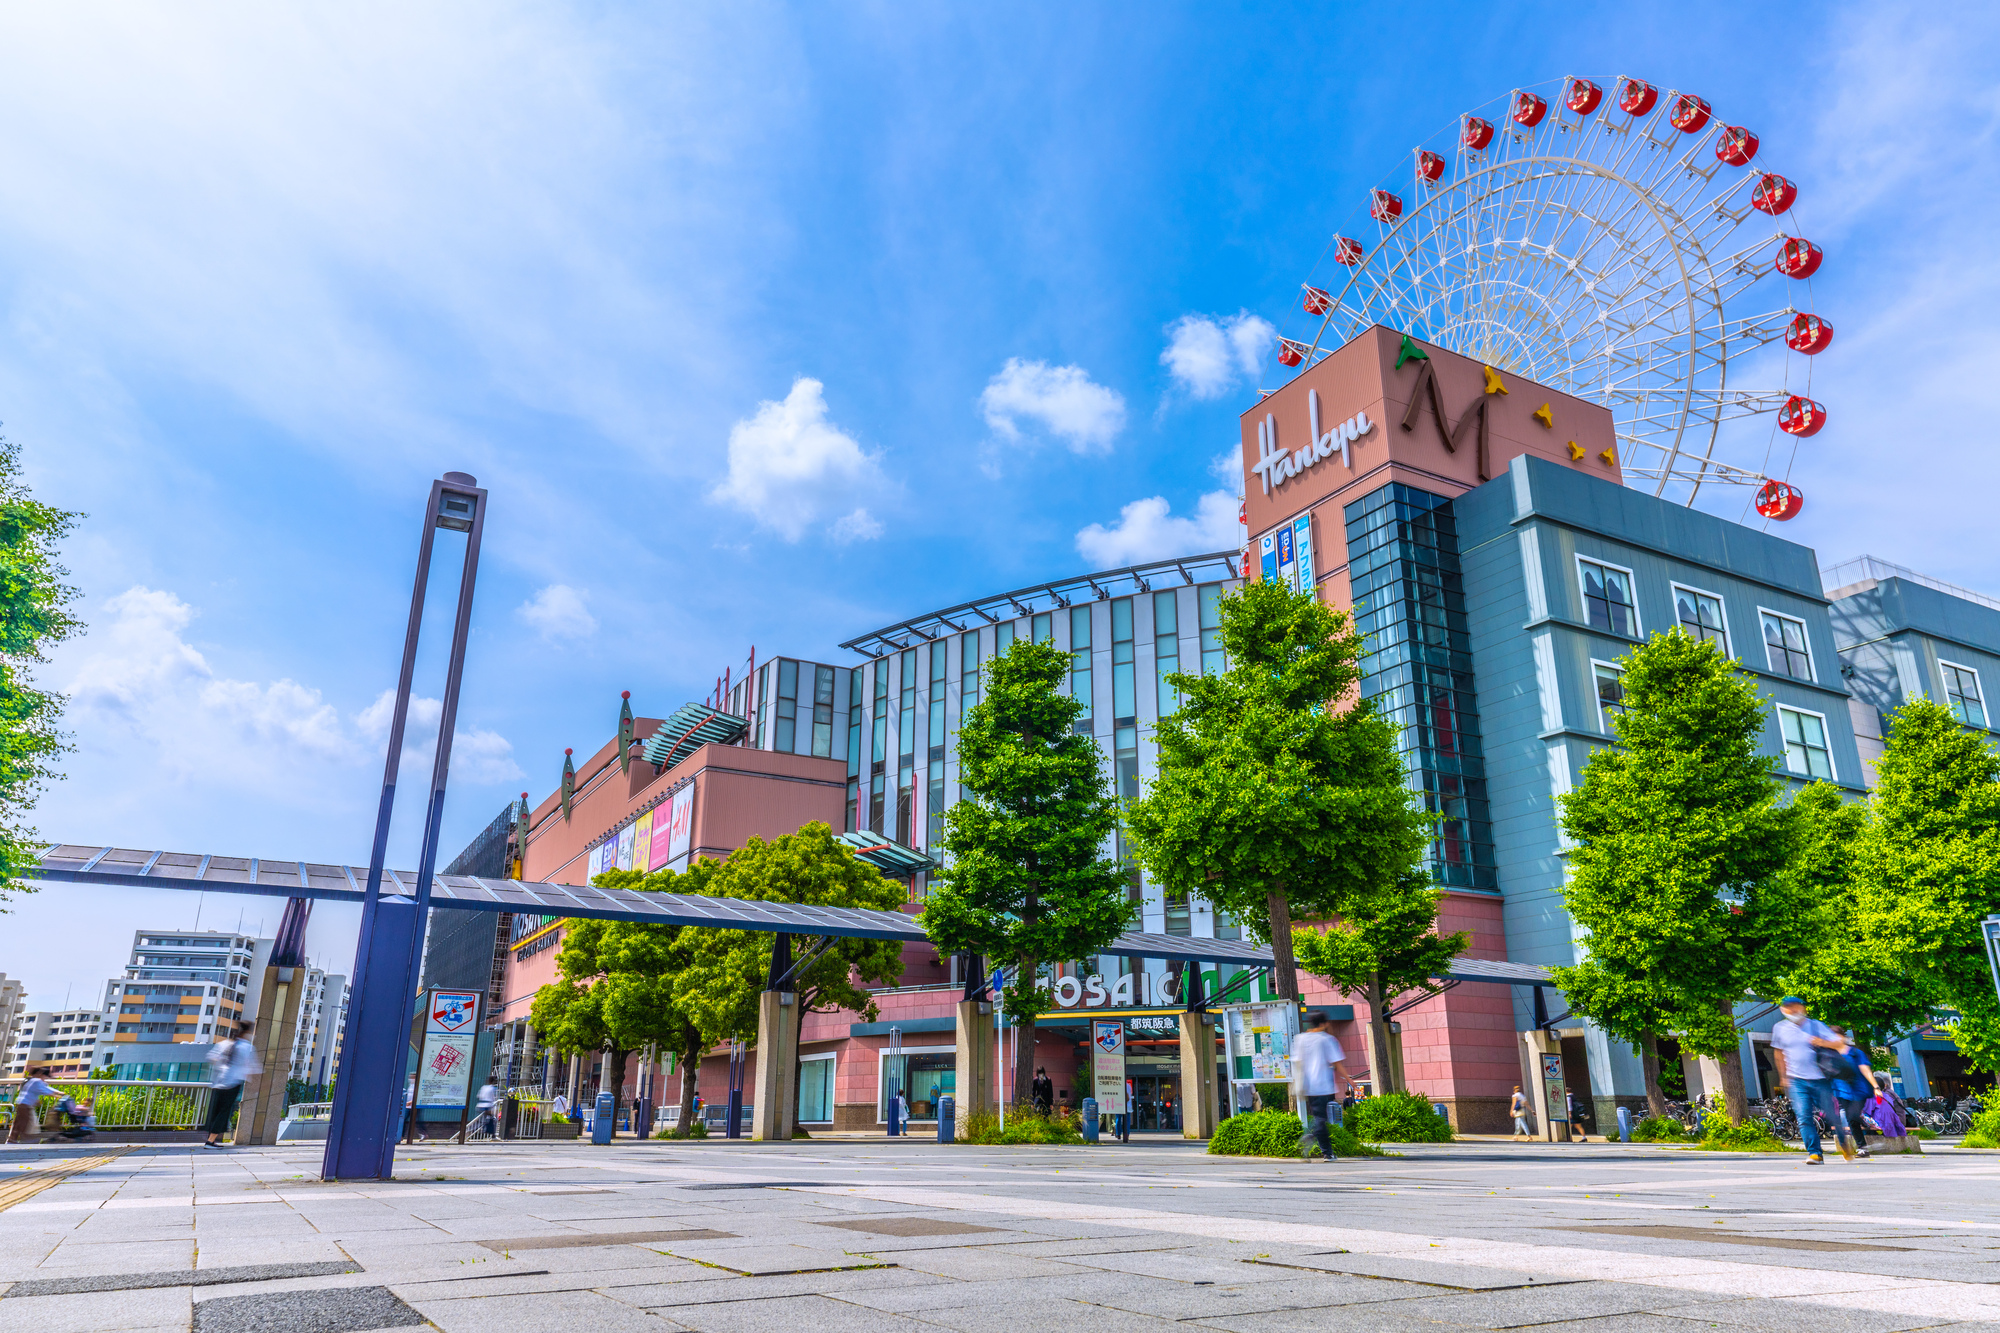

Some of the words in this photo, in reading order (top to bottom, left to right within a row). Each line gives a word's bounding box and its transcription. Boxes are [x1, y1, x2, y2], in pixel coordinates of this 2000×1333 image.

[1251, 388, 1374, 495] Hankyu
[1299, 541, 1311, 597] アフラッ
[671, 799, 691, 843] H&M
[1130, 1015, 1175, 1031] 都筑阪急
